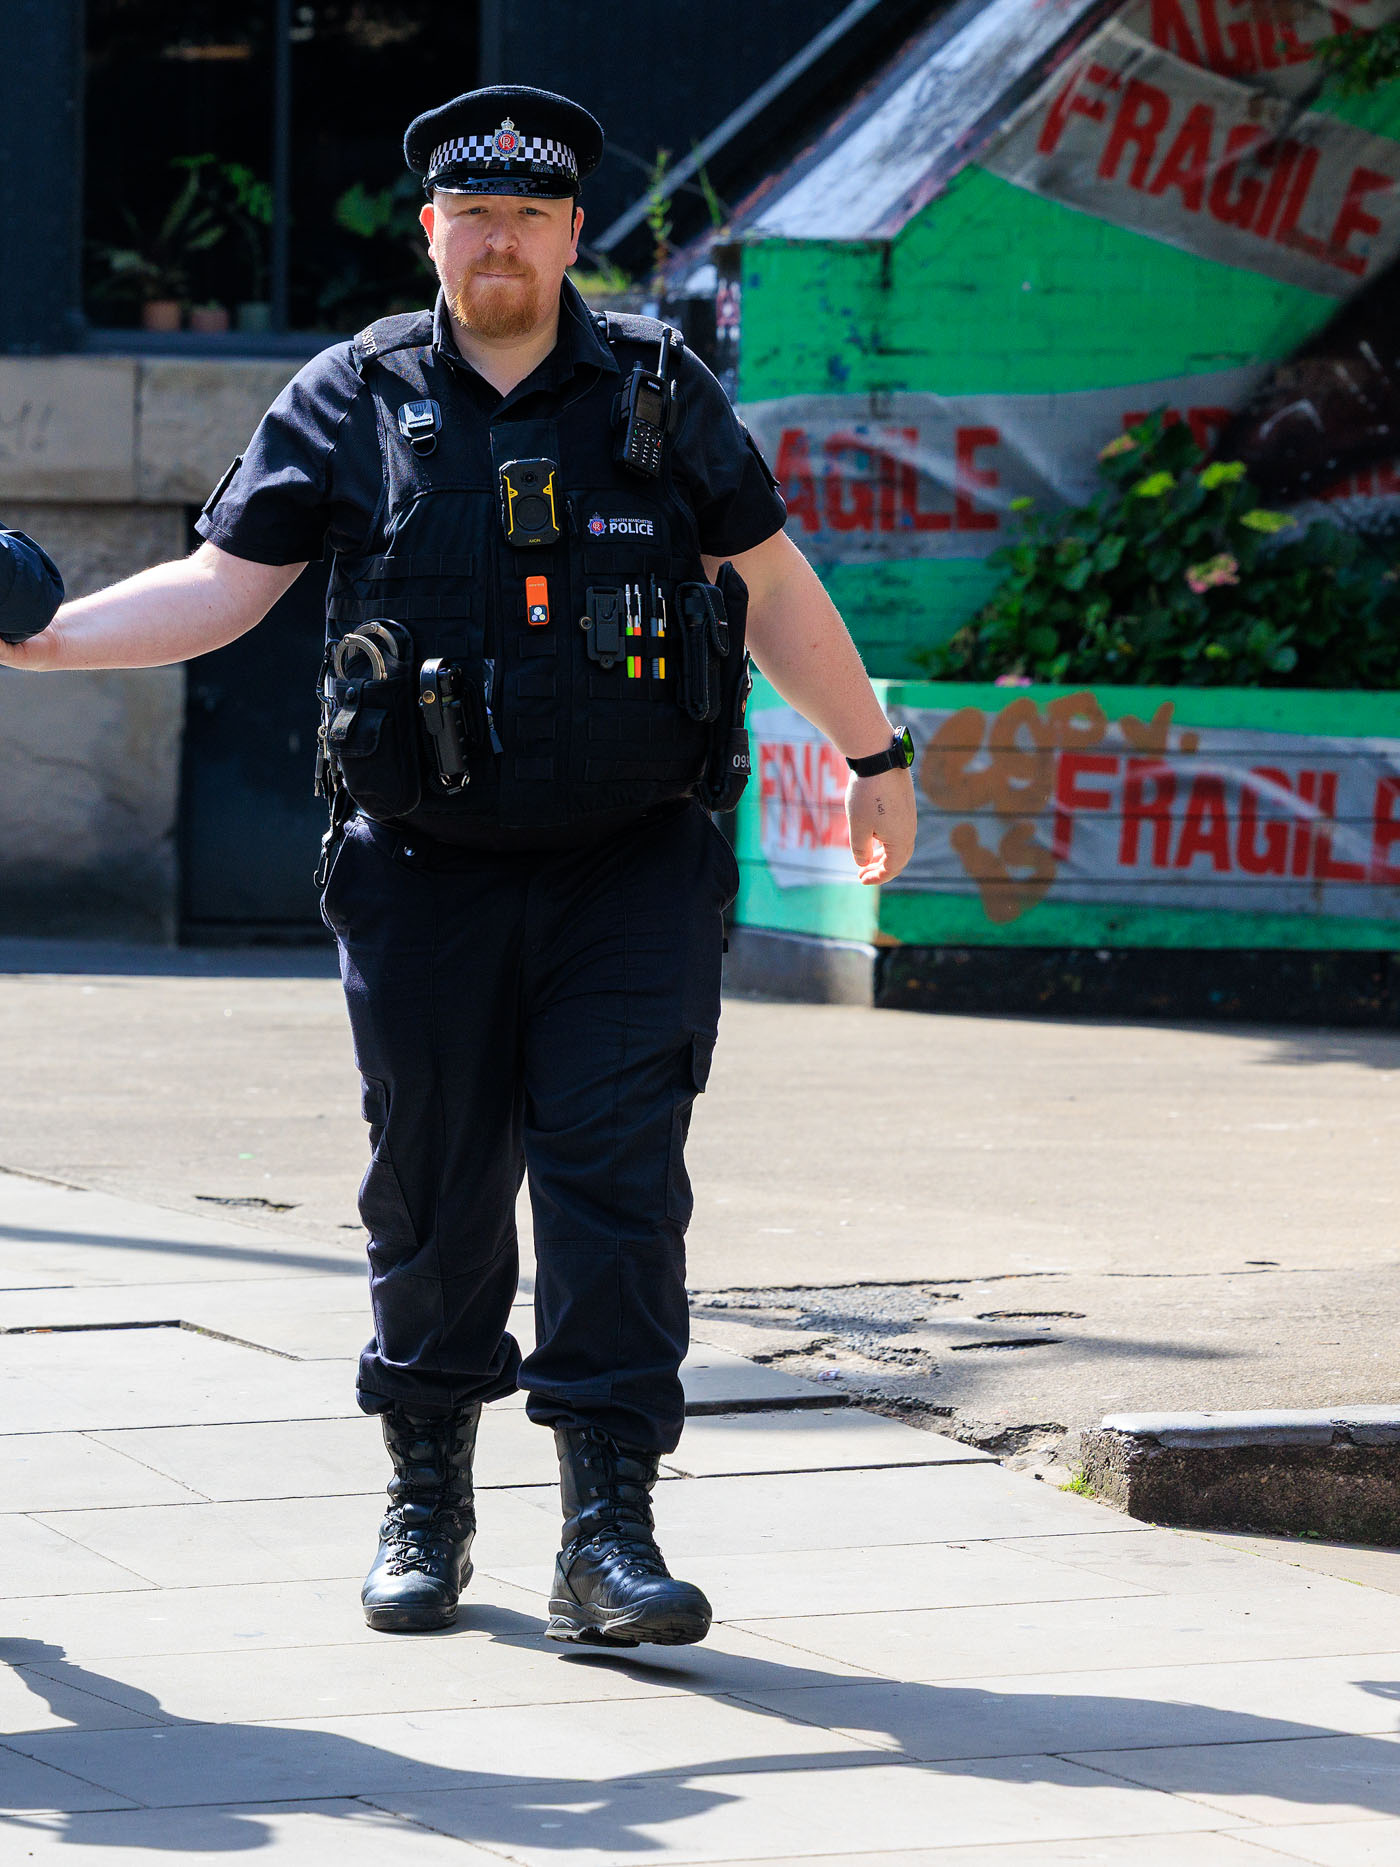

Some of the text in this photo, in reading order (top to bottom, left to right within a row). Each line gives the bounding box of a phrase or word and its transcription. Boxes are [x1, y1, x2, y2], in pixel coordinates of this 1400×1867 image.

[1037, 65, 1396, 277] FRAGILE
[609, 522, 654, 536] POLICE
[773, 425, 1000, 533] AGILE
[1052, 752, 1400, 885] FRAGILE
